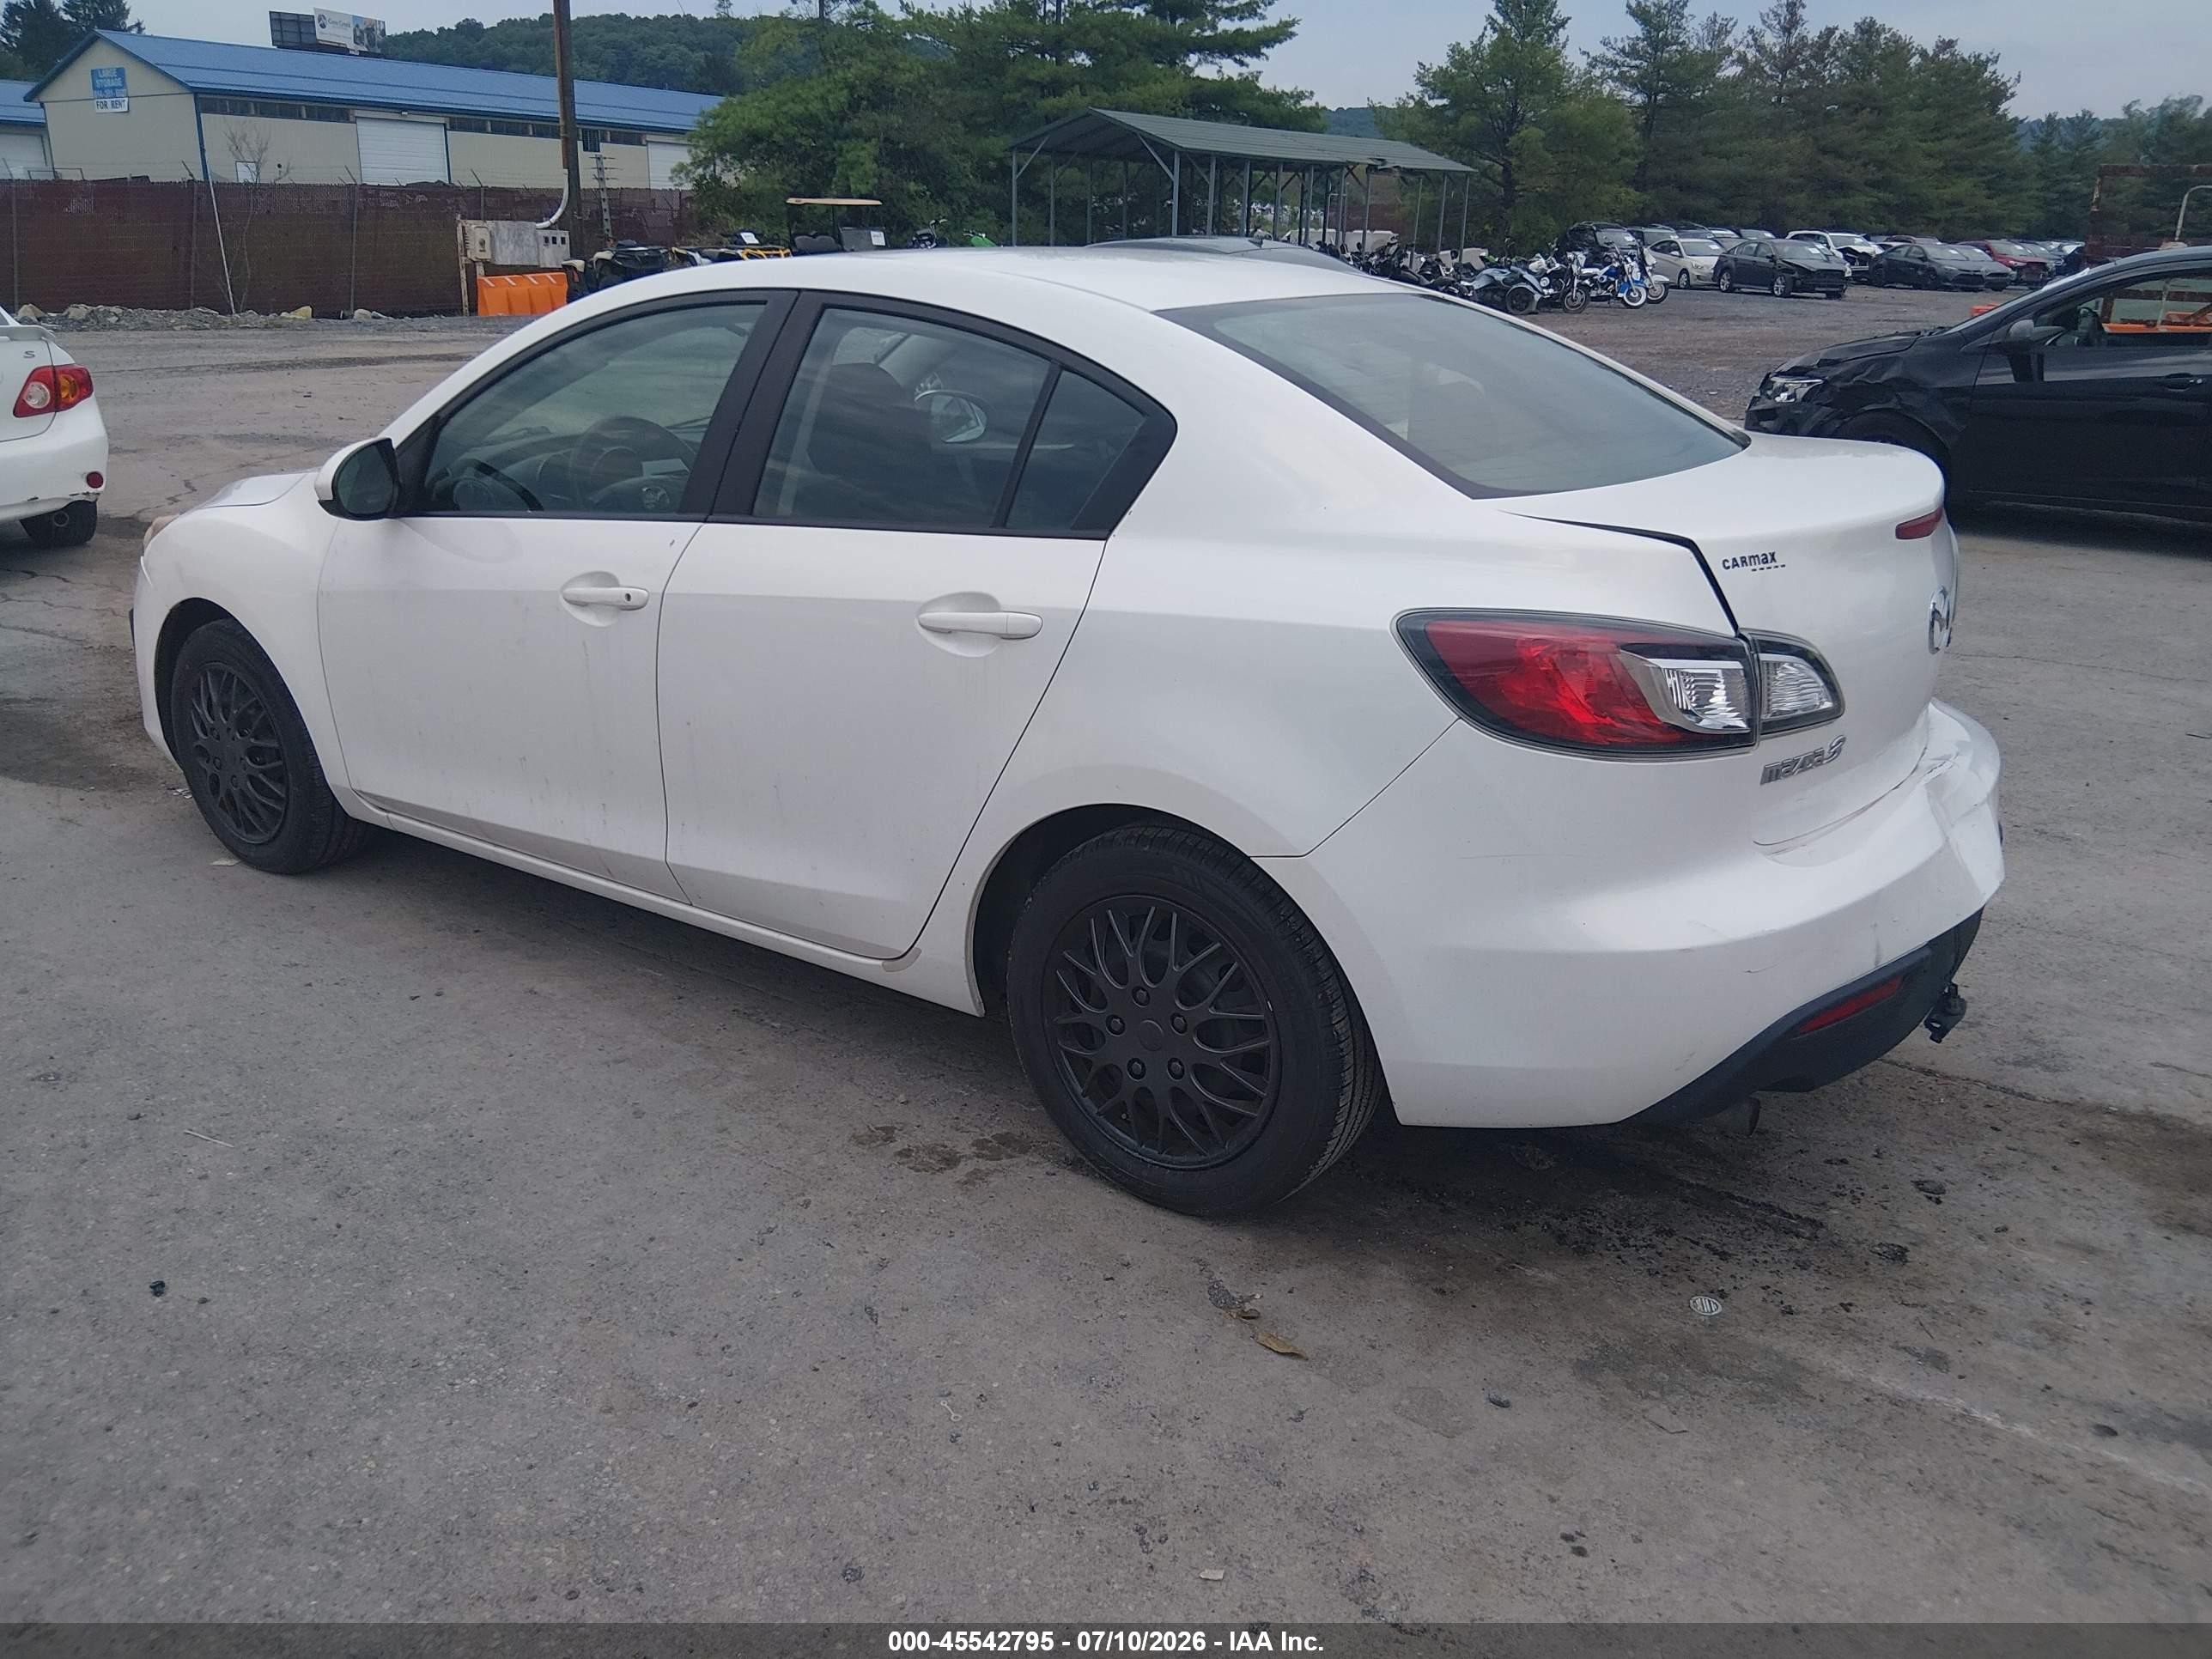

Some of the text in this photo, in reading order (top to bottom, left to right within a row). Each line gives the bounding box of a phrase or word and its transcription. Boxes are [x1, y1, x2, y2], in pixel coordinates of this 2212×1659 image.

[95, 99, 126, 110] FOR RENT
[23, 350, 35, 359] S
